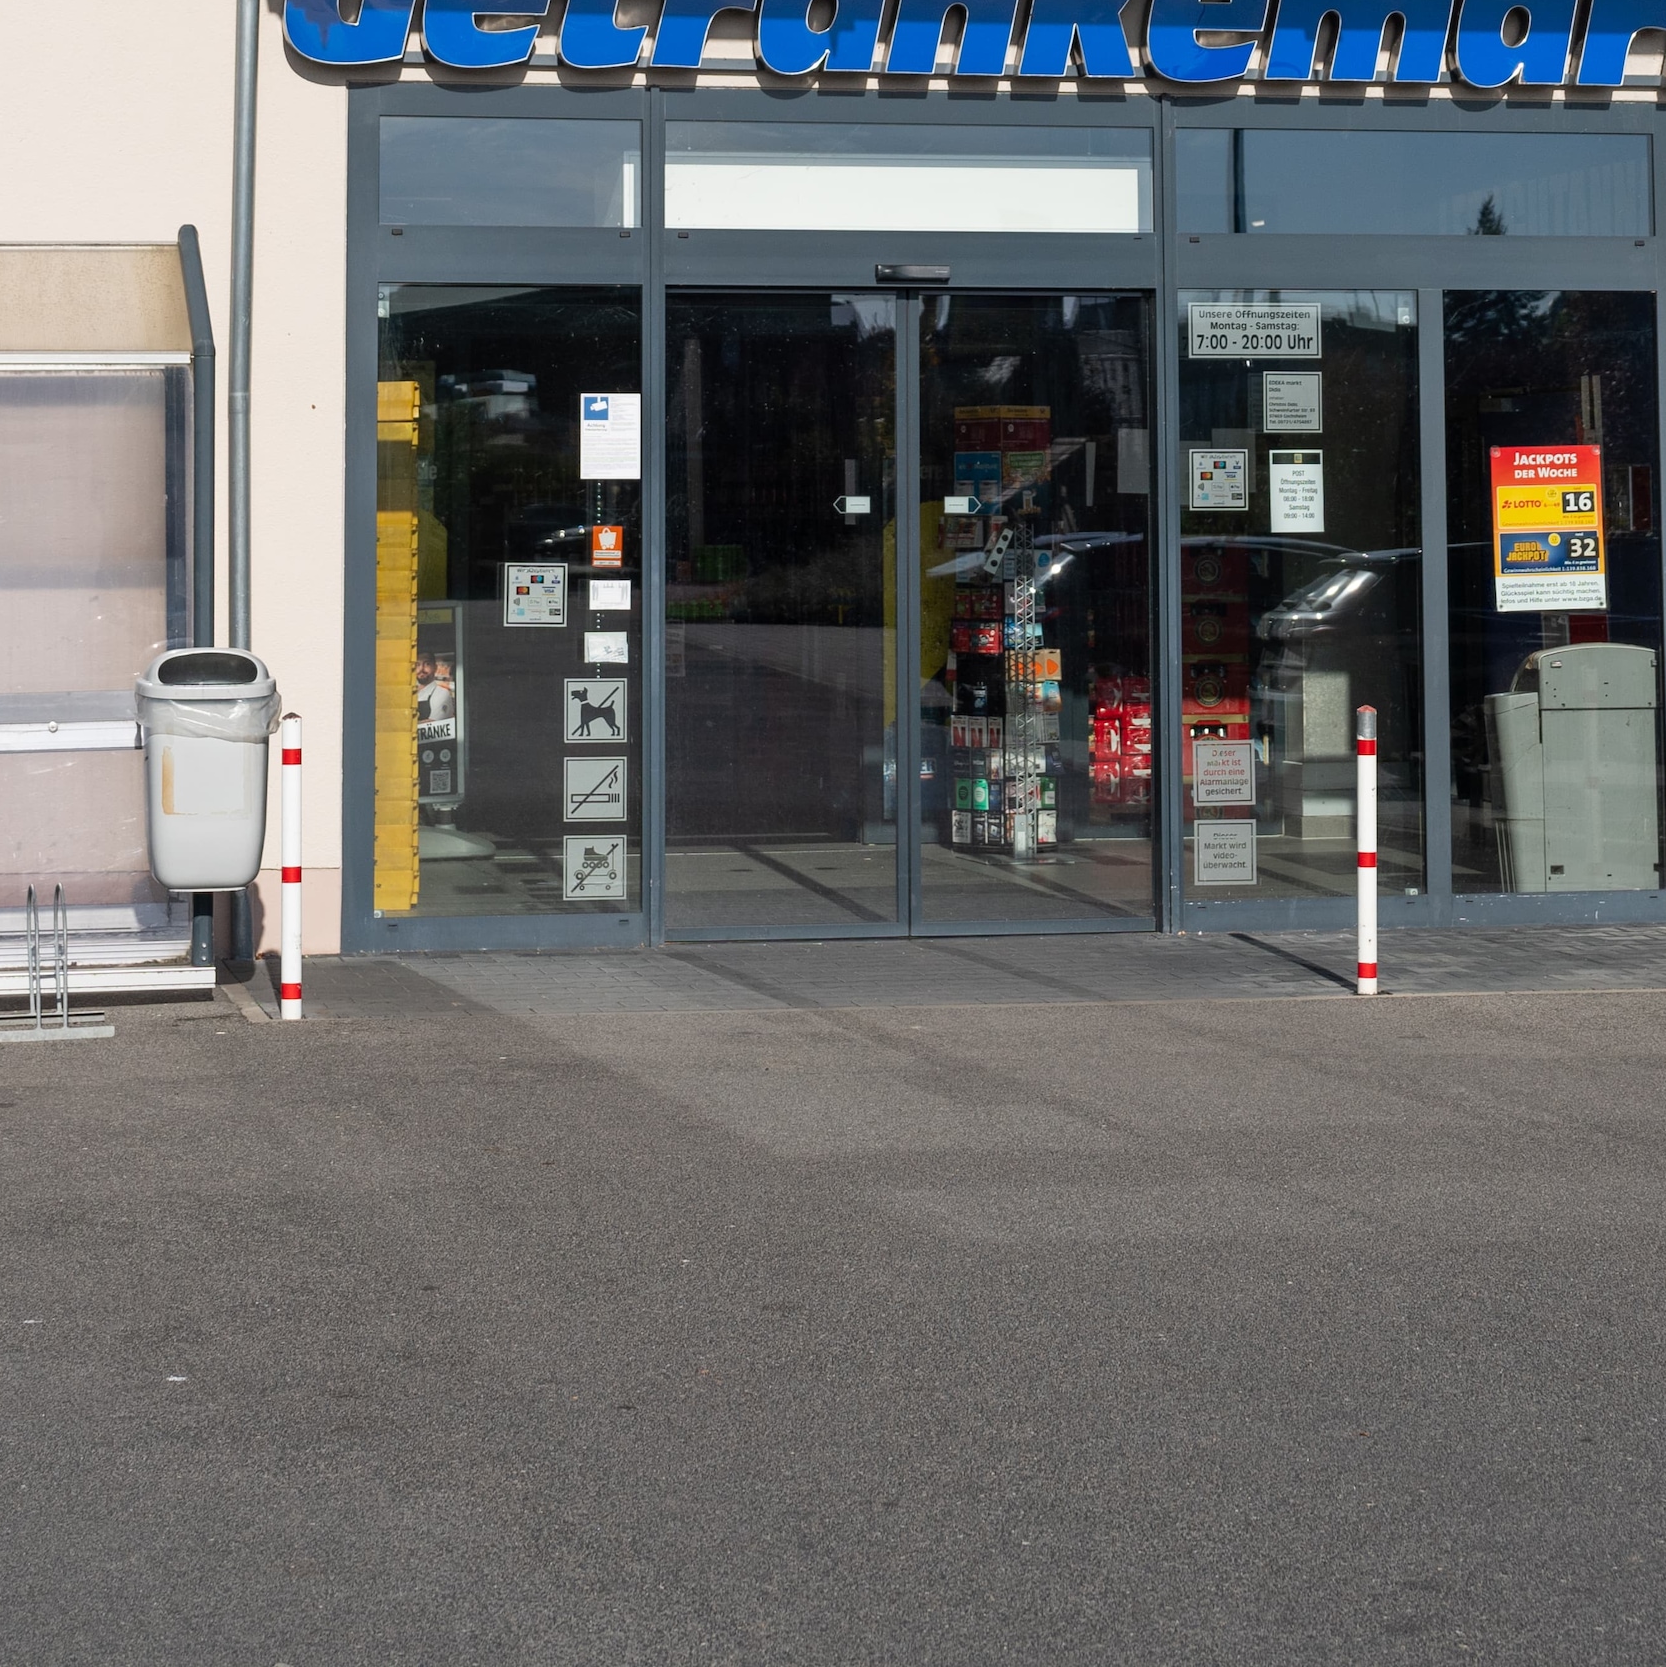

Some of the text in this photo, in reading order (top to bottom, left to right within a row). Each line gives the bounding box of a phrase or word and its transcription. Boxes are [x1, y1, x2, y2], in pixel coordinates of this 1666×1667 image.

[1199, 309, 1311, 320] Unsere Öffnungszeiten
[1210, 322, 1247, 331] Montag
[1196, 334, 1228, 350] 7:00
[1242, 334, 1282, 350] 20:00
[1287, 334, 1313, 350] Uhr
[1514, 452, 1577, 465] JACKPOTS
[1514, 467, 1578, 479] DER WOCHE
[1514, 500, 1541, 508] LOTTO
[1565, 492, 1592, 511] 16
[1514, 538, 1596, 557] EURO 32
[1506, 550, 1547, 562] JACKPOT
[1212, 749, 1236, 757] Deser
[1200, 778, 1249, 786] Alarmanlage
[1205, 787, 1244, 797] gesichert.
[1204, 841, 1247, 850] Markt wird
